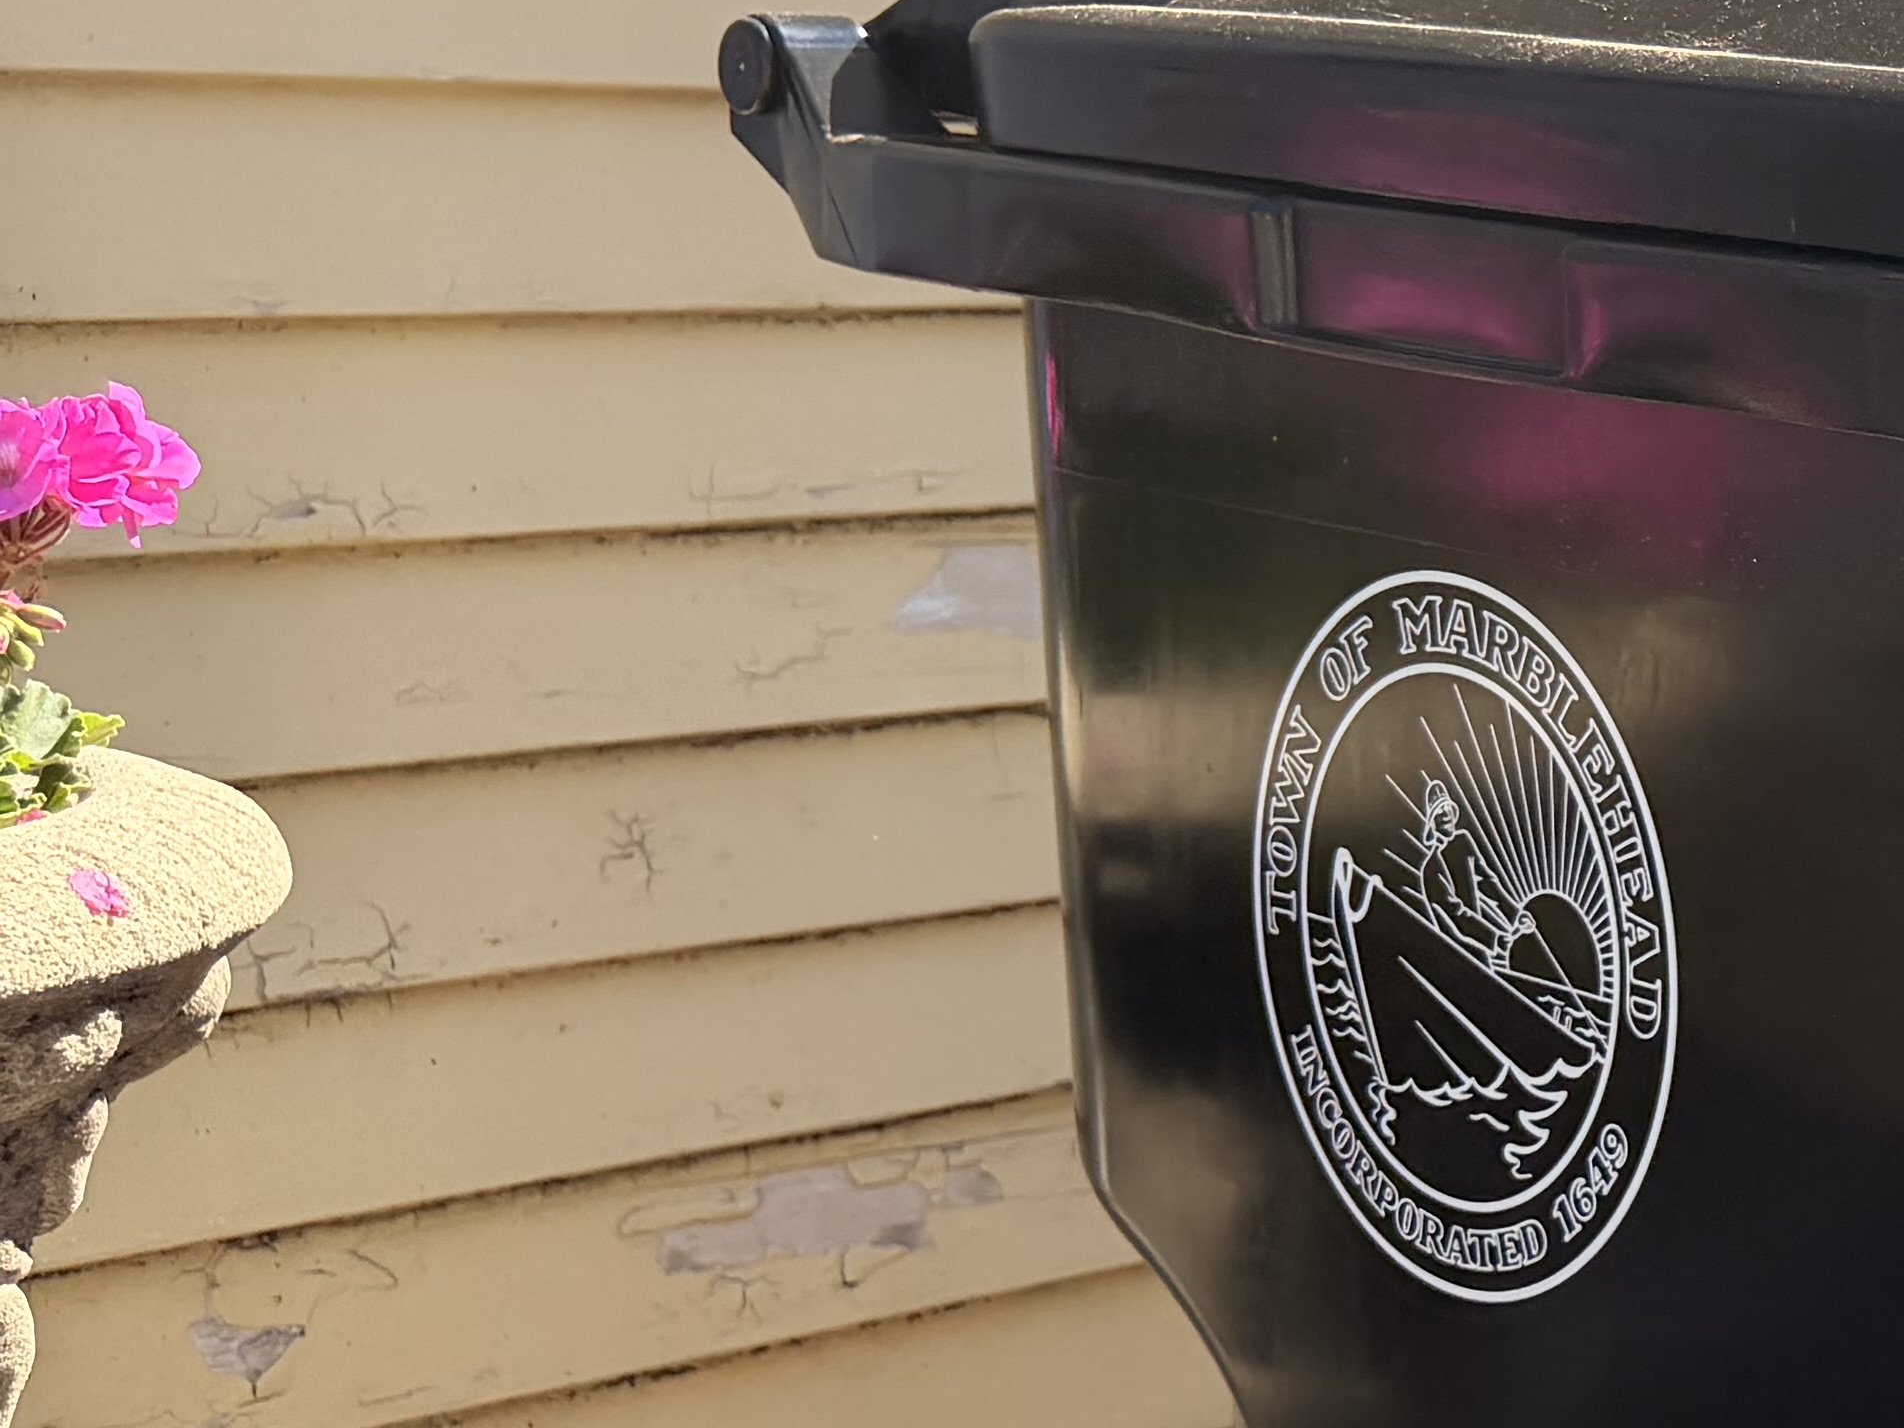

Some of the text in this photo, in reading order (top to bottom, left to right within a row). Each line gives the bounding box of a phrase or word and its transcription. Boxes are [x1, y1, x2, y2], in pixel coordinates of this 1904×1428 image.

[1266, 594, 1664, 1041] TOWN OF MARBLEHEAD
[1288, 1025, 1630, 1274] INCORPORATED 1649
